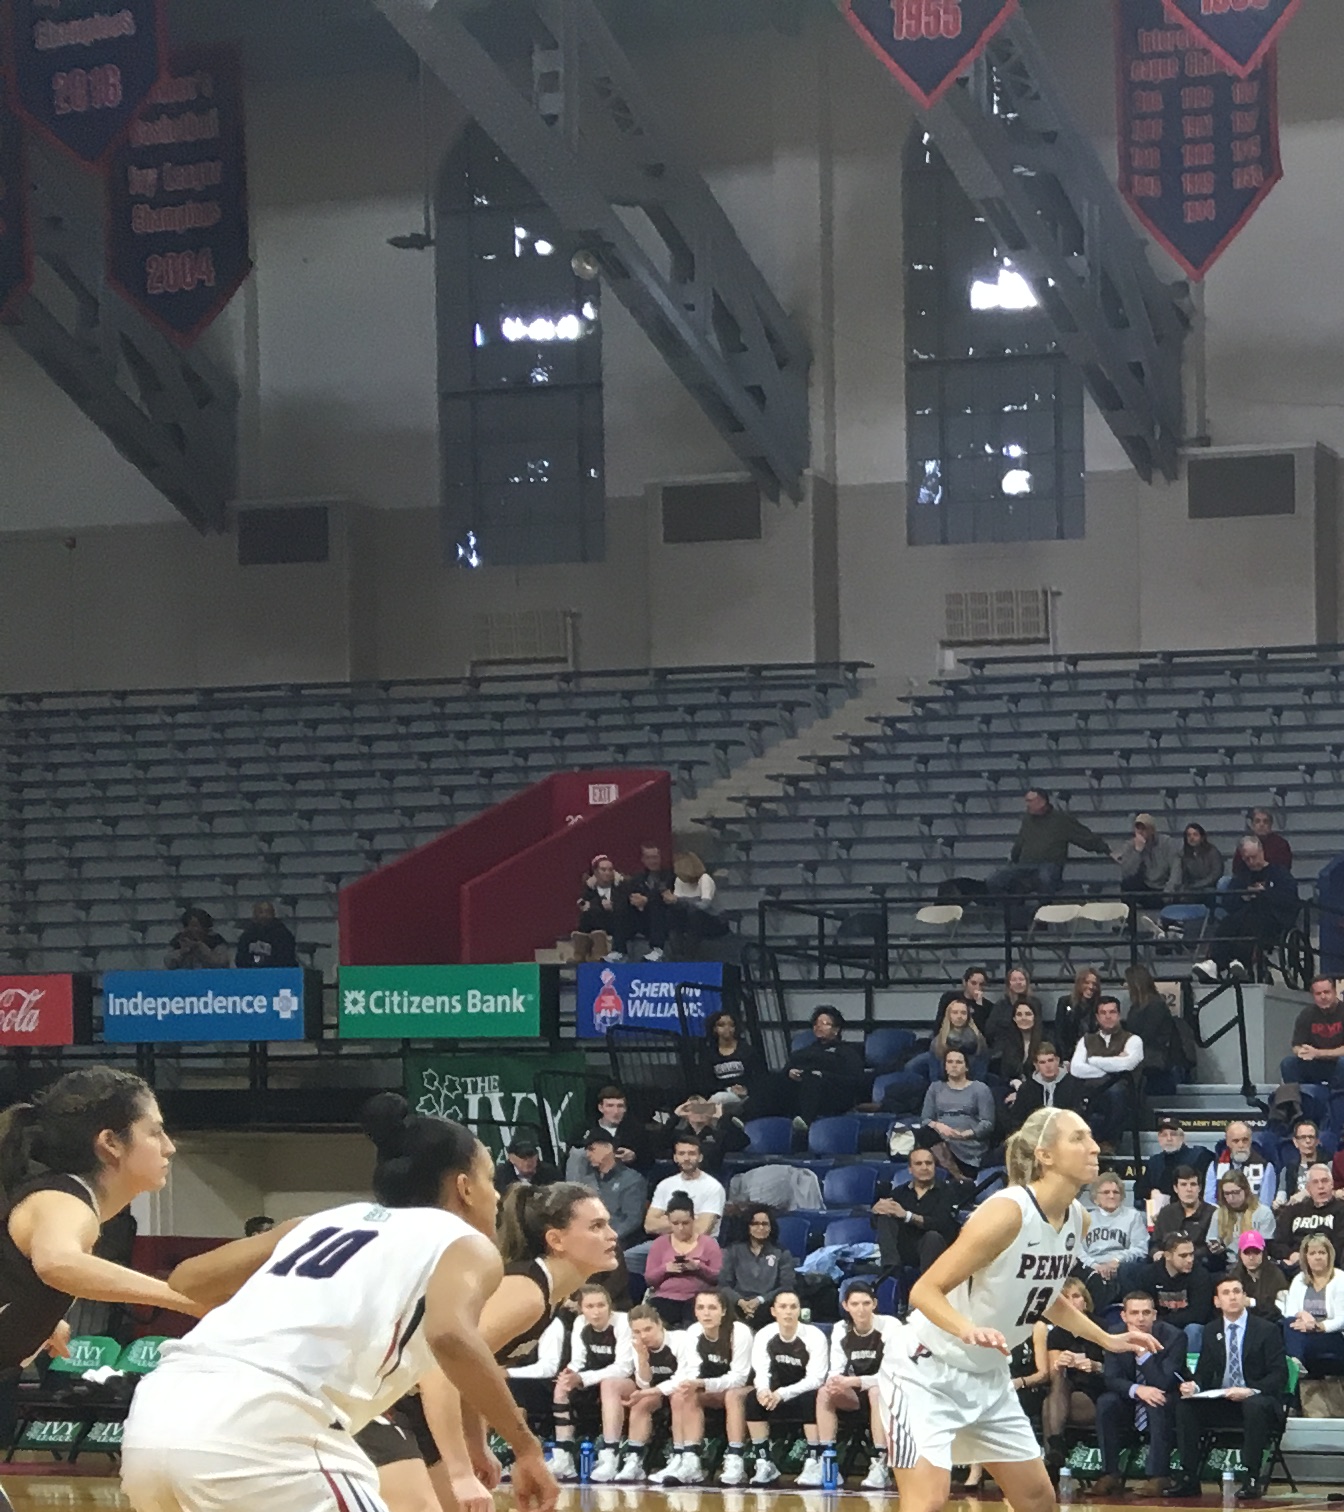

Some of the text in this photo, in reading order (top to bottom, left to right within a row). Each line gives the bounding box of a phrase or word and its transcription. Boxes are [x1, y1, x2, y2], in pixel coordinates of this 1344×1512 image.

[108, 991, 267, 1020] Independence
[369, 987, 526, 1014] Citizens Bank
[462, 1075, 499, 1094] THE
[1085, 1228, 1128, 1248] BROWN
[266, 1226, 379, 1279] 10
[1015, 1286, 1054, 1327] 13
[73, 1346, 105, 1360] IVY
[43, 1421, 83, 1435] IVY
